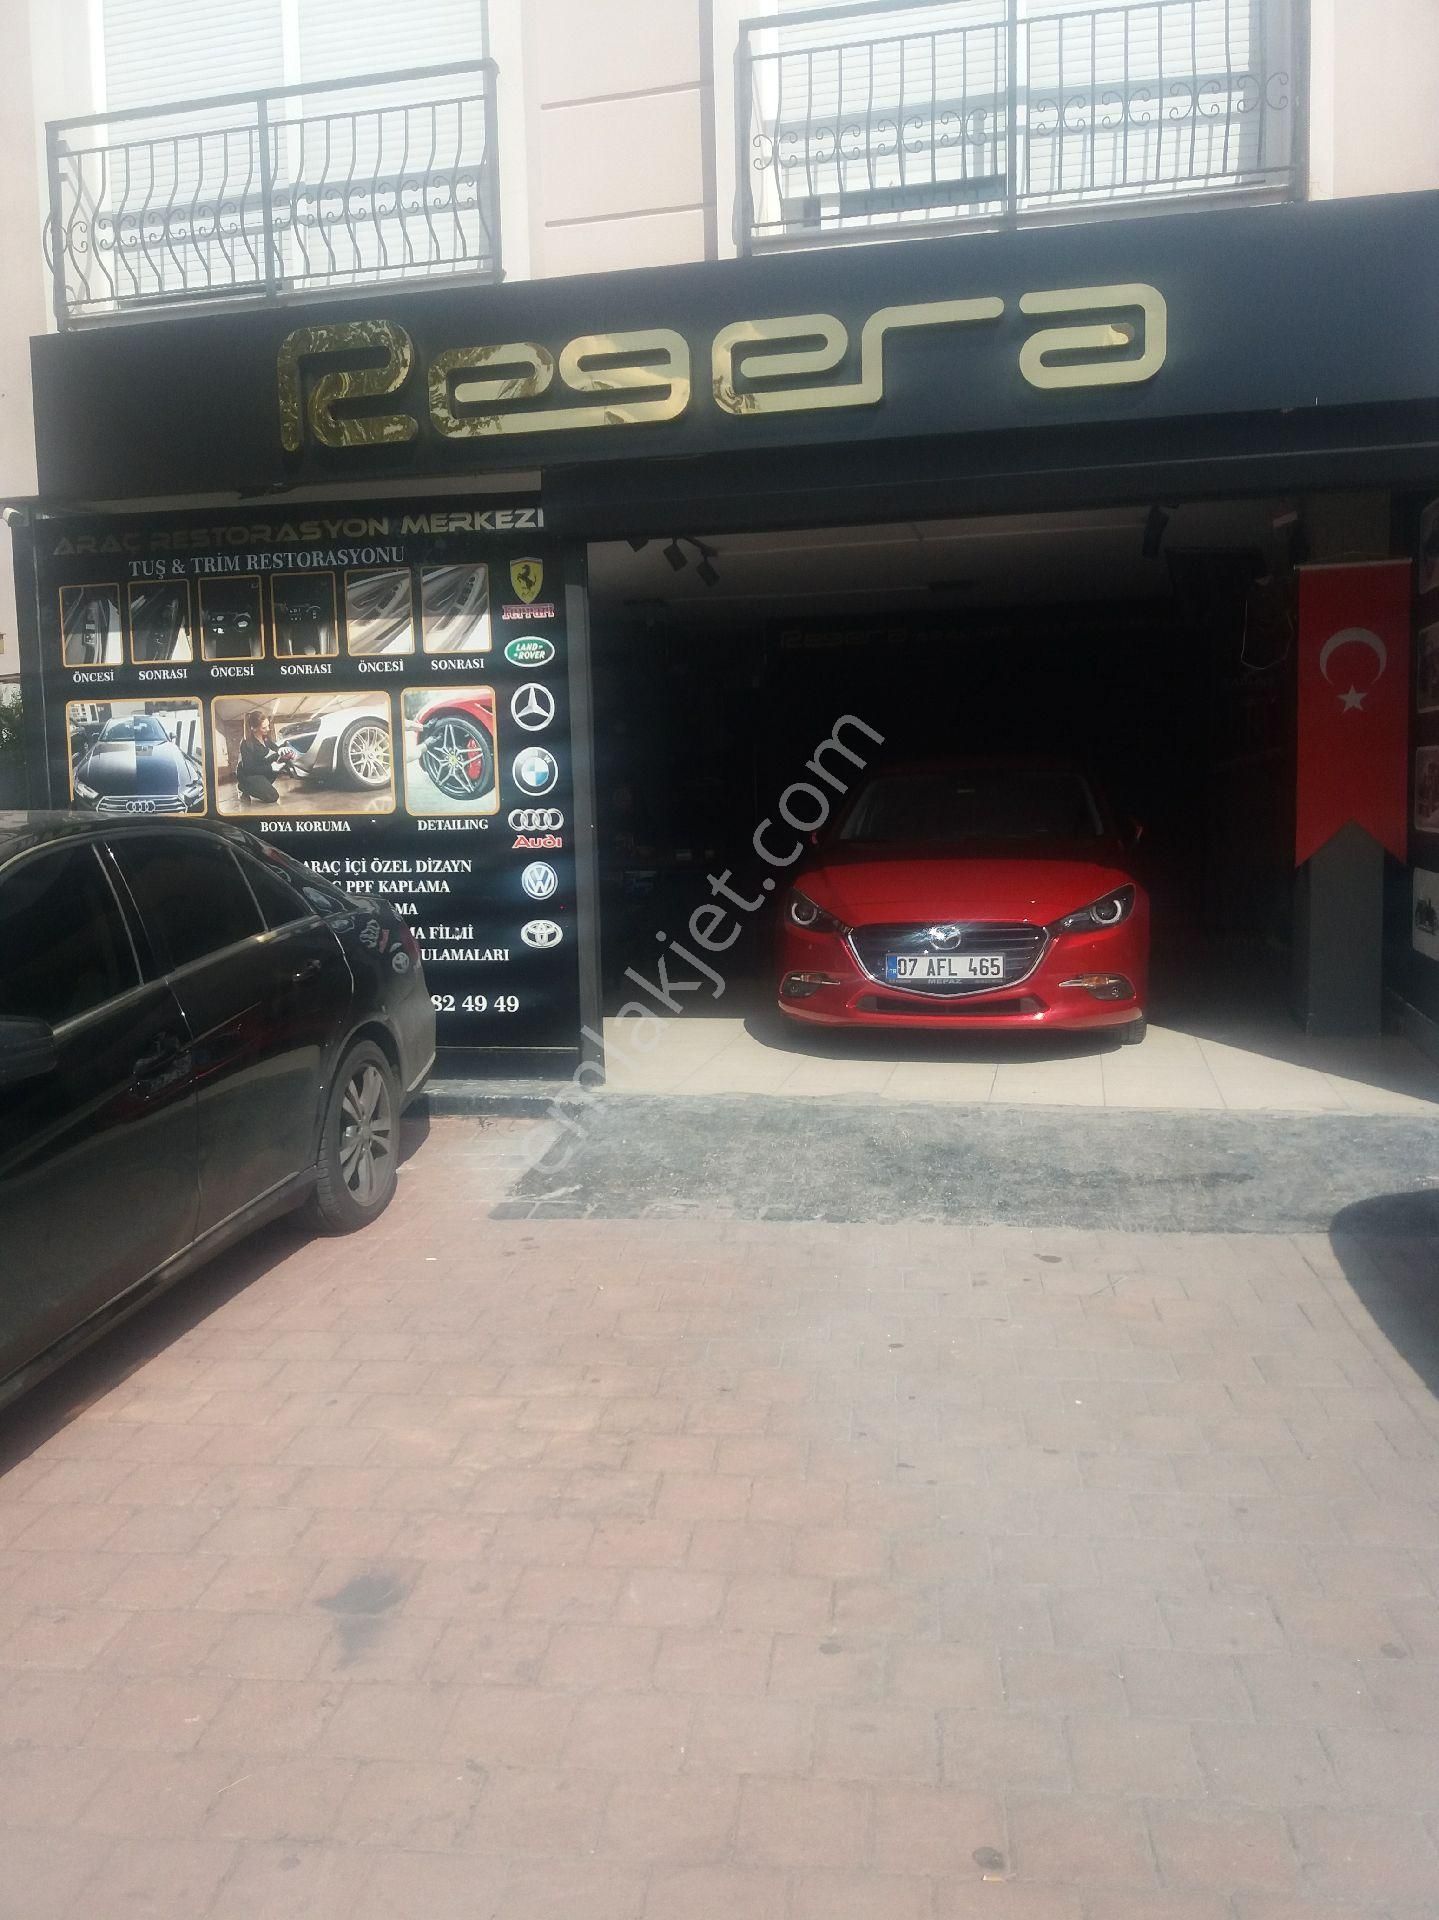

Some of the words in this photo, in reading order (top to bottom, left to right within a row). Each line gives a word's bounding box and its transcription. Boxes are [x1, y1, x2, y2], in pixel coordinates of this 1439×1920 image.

[277, 283, 1168, 452] Regera
[148, 517, 389, 551] RESTORASYON
[128, 560, 166, 580] TUŞ
[171, 559, 186, 574] &
[191, 552, 240, 574] TRİM
[245, 546, 405, 571] RESTORASYONU
[515, 642, 539, 651] LAND
[517, 650, 546, 660] ROVER
[210, 663, 255, 678] ÖNCESİ
[280, 663, 332, 676] SONRASI
[358, 658, 404, 674] ÖNCESİ
[431, 658, 485, 671] SONRASI
[72, 670, 115, 683] ÖNCESİ
[138, 668, 188, 681] SONRASI
[260, 821, 293, 832] BOYA
[296, 820, 351, 832] KORUMA
[417, 819, 489, 831] DETAILING
[511, 834, 563, 849] Audi
[344, 857, 367, 876] İÇİ
[371, 857, 412, 873] ÖZEL
[415, 857, 472, 873] DİZAYN
[346, 880, 375, 893] PPF
[378, 880, 451, 893] KAPLAMA
[897, 958, 918, 976] 07
[926, 958, 958, 976] AFL
[968, 957, 1001, 976] 465
[461, 994, 488, 1012] 49
[493, 995, 520, 1013] 49
